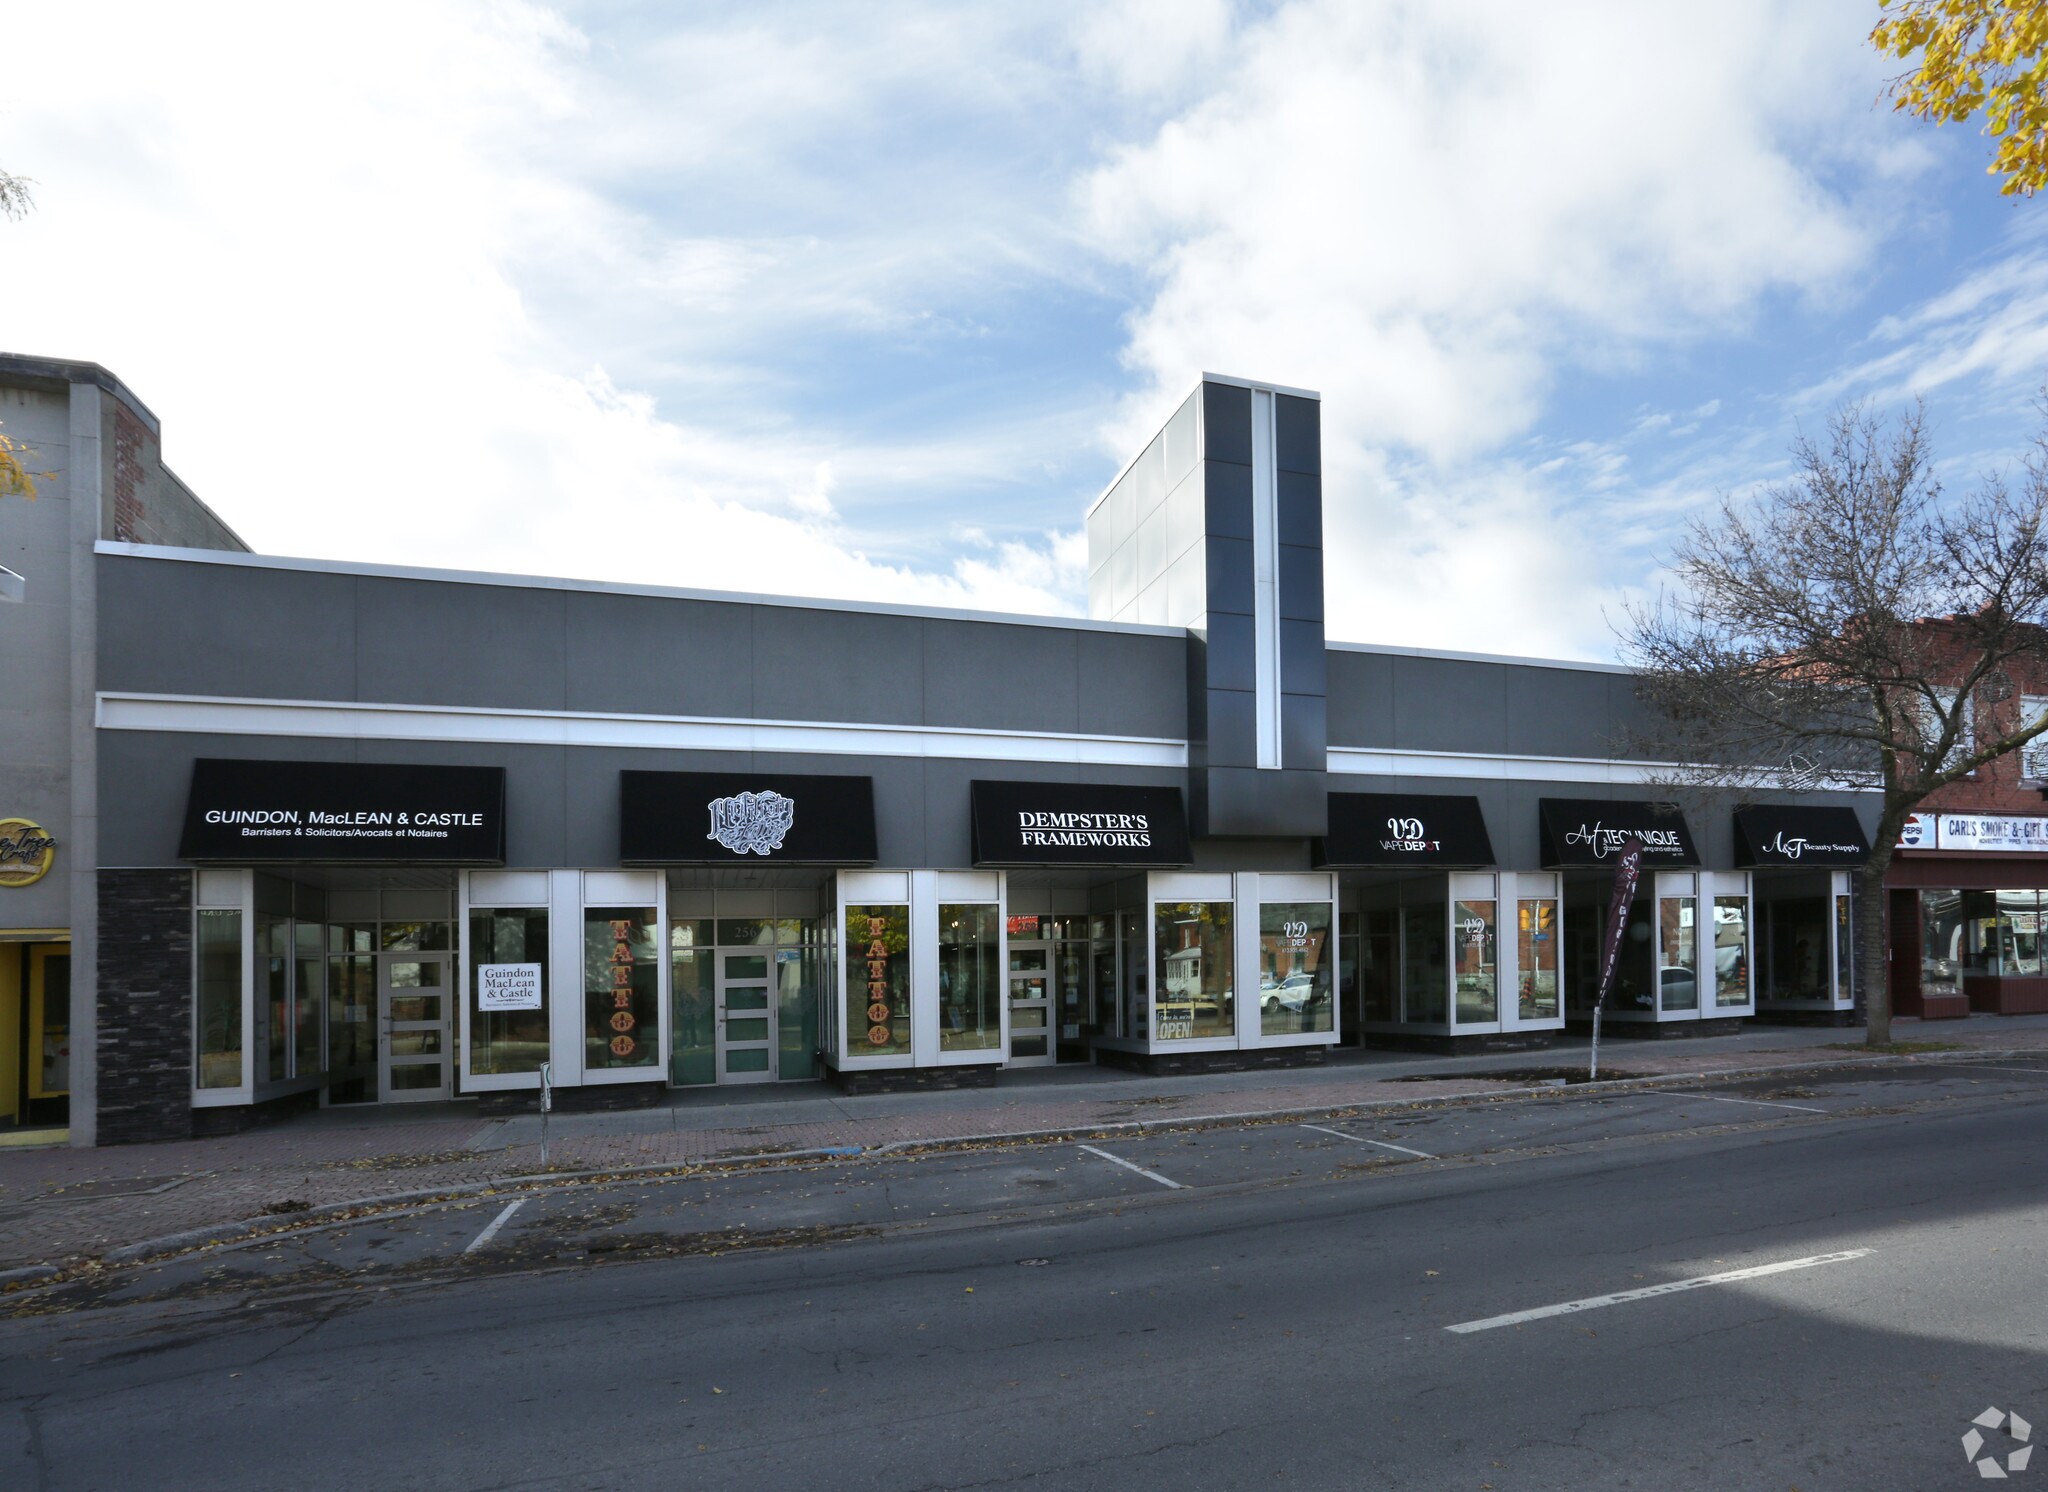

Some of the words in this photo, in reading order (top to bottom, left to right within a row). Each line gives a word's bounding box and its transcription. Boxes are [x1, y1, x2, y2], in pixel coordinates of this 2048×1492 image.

[205, 810, 302, 825] GUINDON,
[308, 811, 392, 825] MacLEAN
[397, 812, 409, 825] &
[414, 812, 483, 826] CASTLE
[1019, 811, 1148, 829] DEMPSTER'S
[241, 827, 291, 836] Barristers
[294, 827, 302, 836] &
[305, 828, 393, 837] Solicitors/Avocats
[395, 829, 405, 837] et
[408, 829, 448, 838] Notaires
[1902, 826, 1923, 835] PEPSI
[1980, 821, 2009, 838] SMOKE
[2011, 822, 2019, 837] &
[2024, 822, 2041, 838] GIFT
[18, 826, 57, 849] Tree
[1021, 831, 1151, 847] FRAMEWORKS
[1803, 843, 1832, 852] Beauty
[1832, 843, 1860, 853] Supply
[735, 926, 757, 938] 256
[485, 967, 534, 978] Guindon
[485, 978, 535, 988] MacLean
[487, 988, 497, 998] &
[499, 987, 533, 998] Castle
[1160, 1022, 1191, 1040] OPEN
